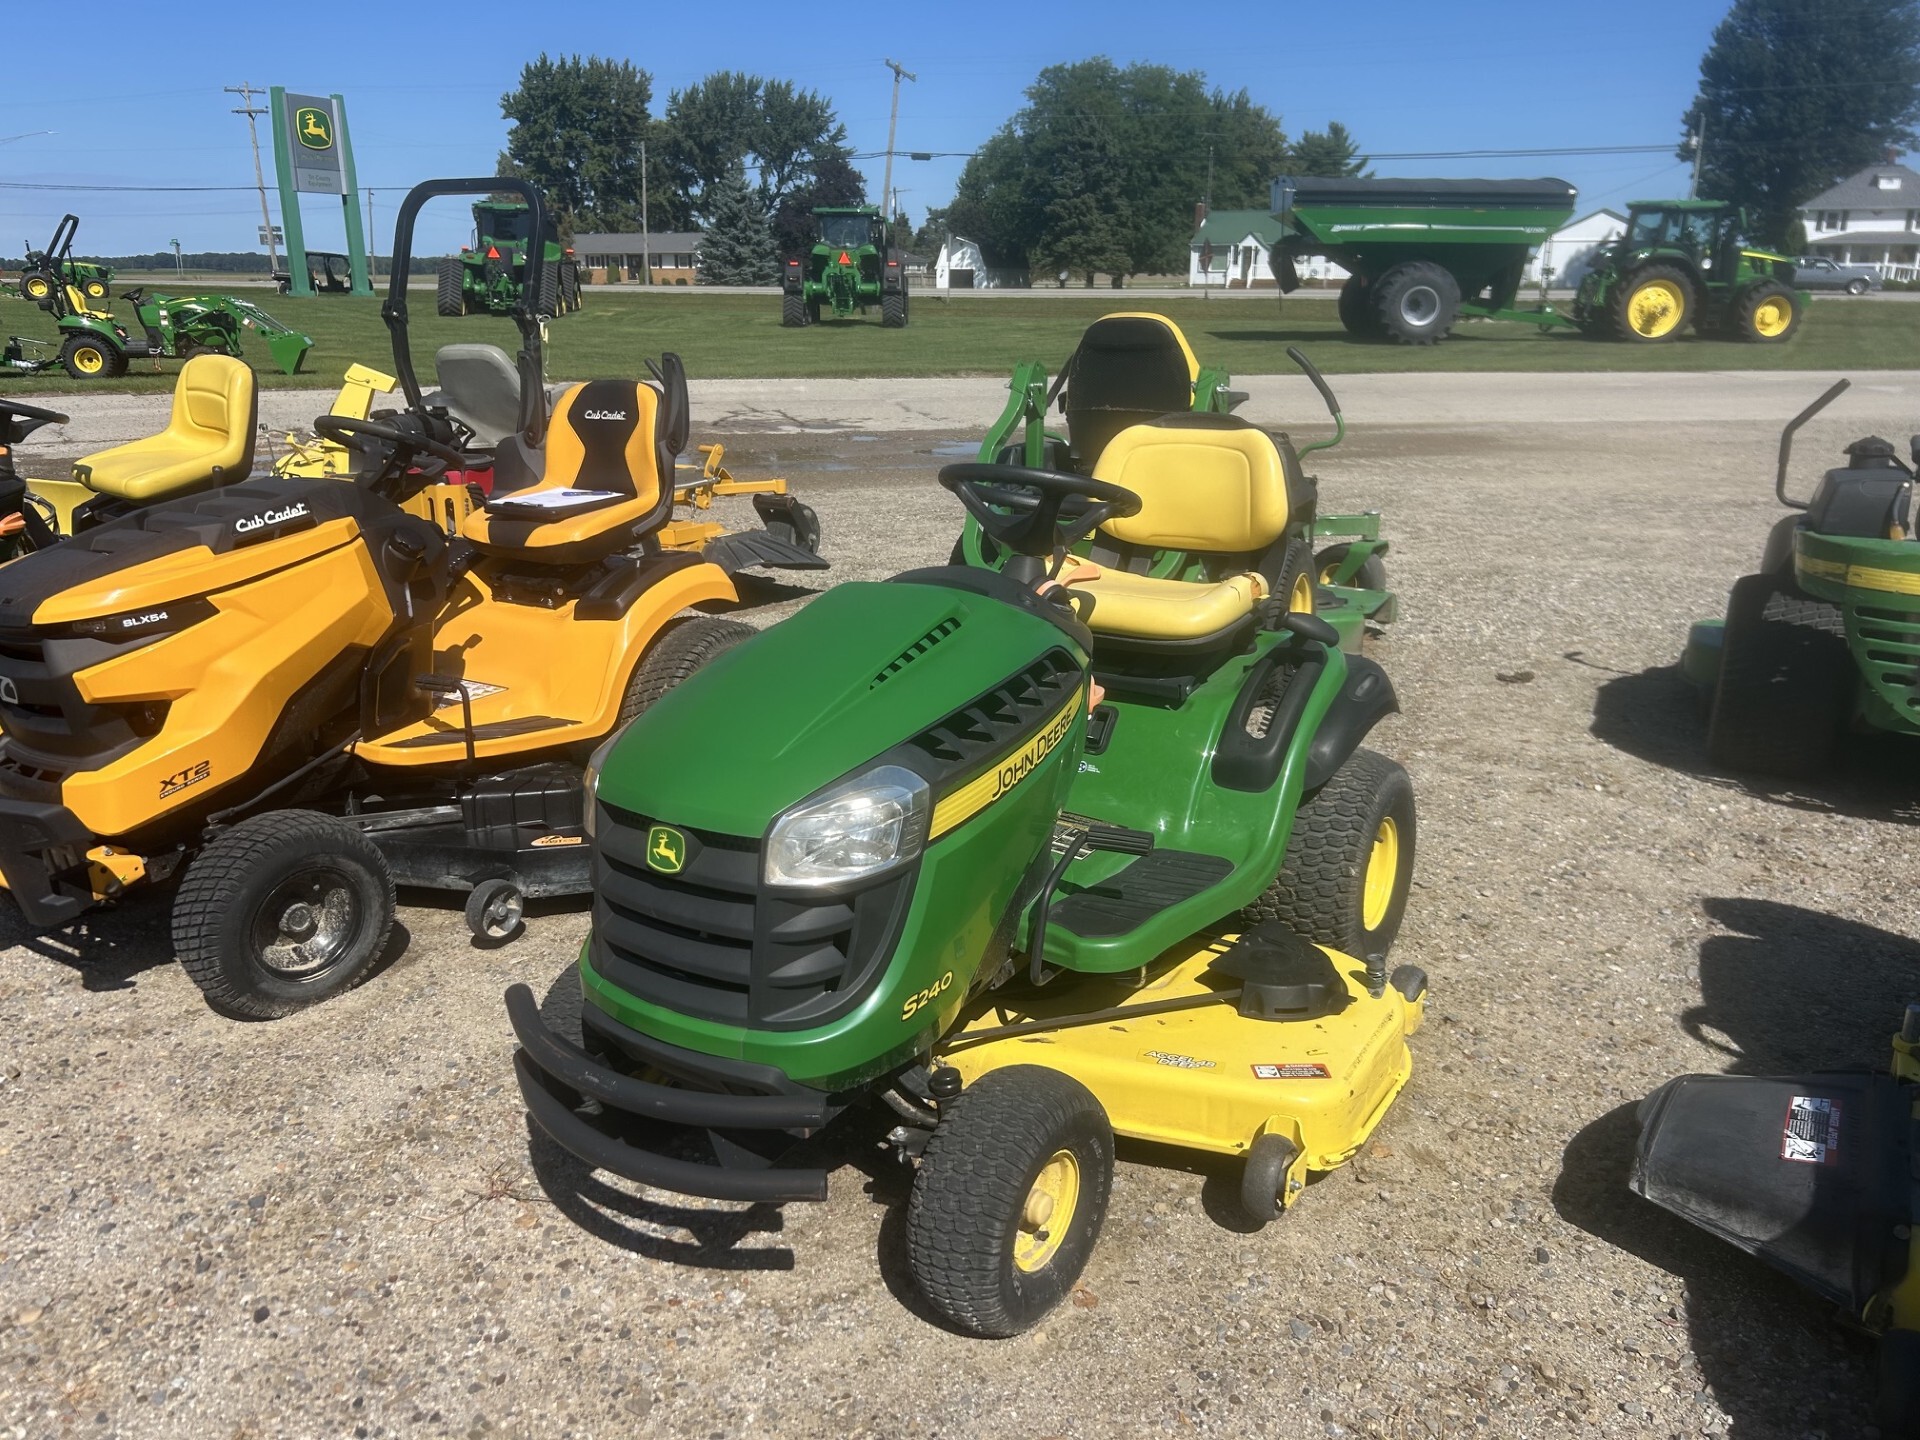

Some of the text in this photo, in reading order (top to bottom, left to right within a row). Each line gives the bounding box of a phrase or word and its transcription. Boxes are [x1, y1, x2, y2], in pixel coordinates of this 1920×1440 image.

[584, 409, 627, 421] Cub Cadet
[235, 502, 308, 532] Cub Cadet
[122, 611, 169, 628] SLX54
[991, 705, 1072, 799] JOHN DEERE
[159, 759, 210, 793] XT2
[901, 970, 953, 1021] S240
[1143, 1050, 1194, 1063] ACCEL
